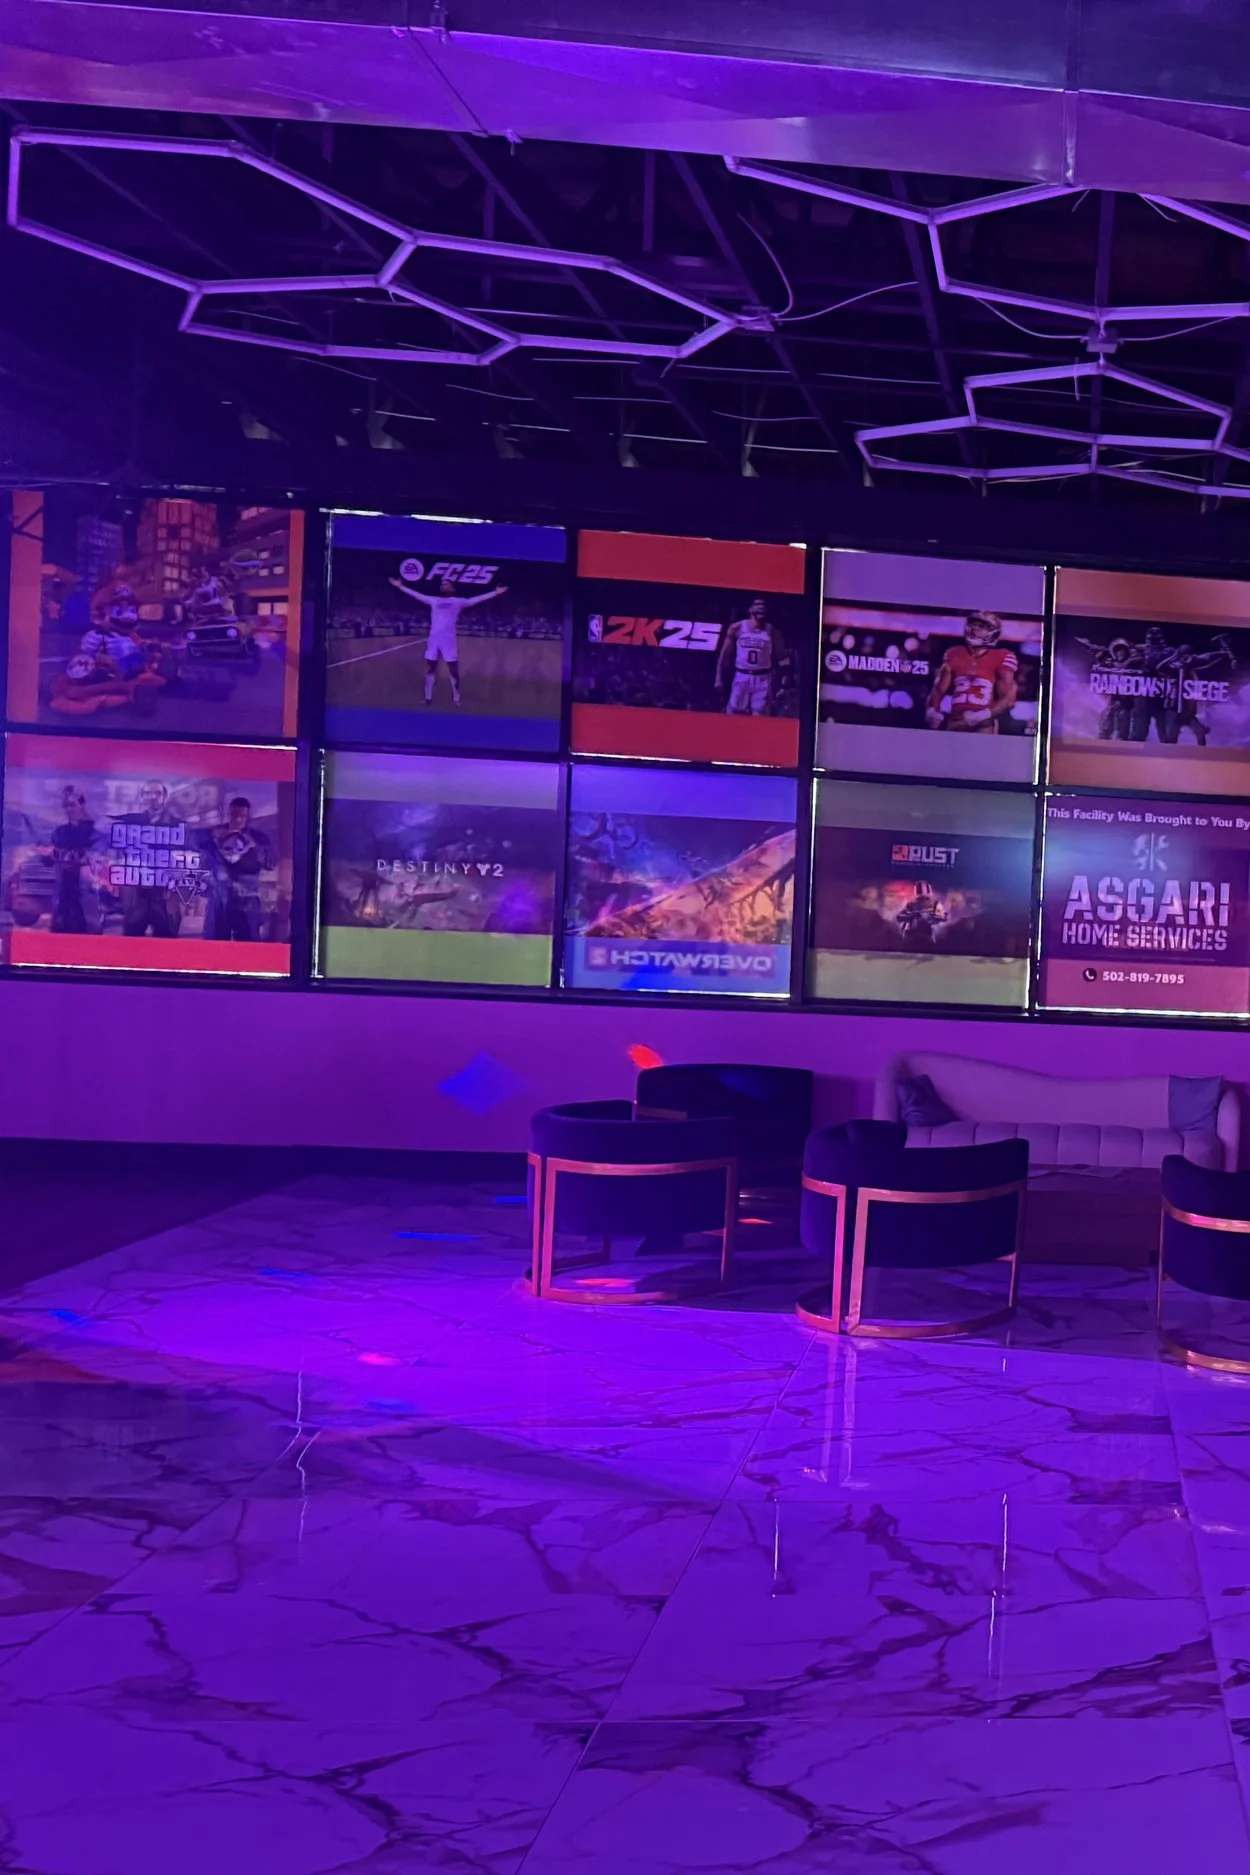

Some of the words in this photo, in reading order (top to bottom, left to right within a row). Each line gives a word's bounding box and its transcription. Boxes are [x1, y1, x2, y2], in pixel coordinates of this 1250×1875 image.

[848, 655, 900, 673] MADDEN
[912, 660, 930, 675] 25
[952, 675, 993, 706] 23
[1183, 680, 1230, 701] SIEGE
[1047, 808, 1070, 819] This
[1073, 809, 1114, 822] Facility
[1118, 811, 1141, 822] Was
[1145, 813, 1191, 827] Brought
[1195, 816, 1207, 826] to
[1211, 817, 1233, 827] You
[909, 846, 960, 865] RUST
[377, 859, 471, 875] DESTINY
[493, 864, 504, 877] 2
[1064, 875, 1231, 926] ASGARI
[1062, 922, 1119, 947] HOME
[1126, 925, 1228, 951] SERVICES
[1102, 971, 1184, 984] 502-819-7895
